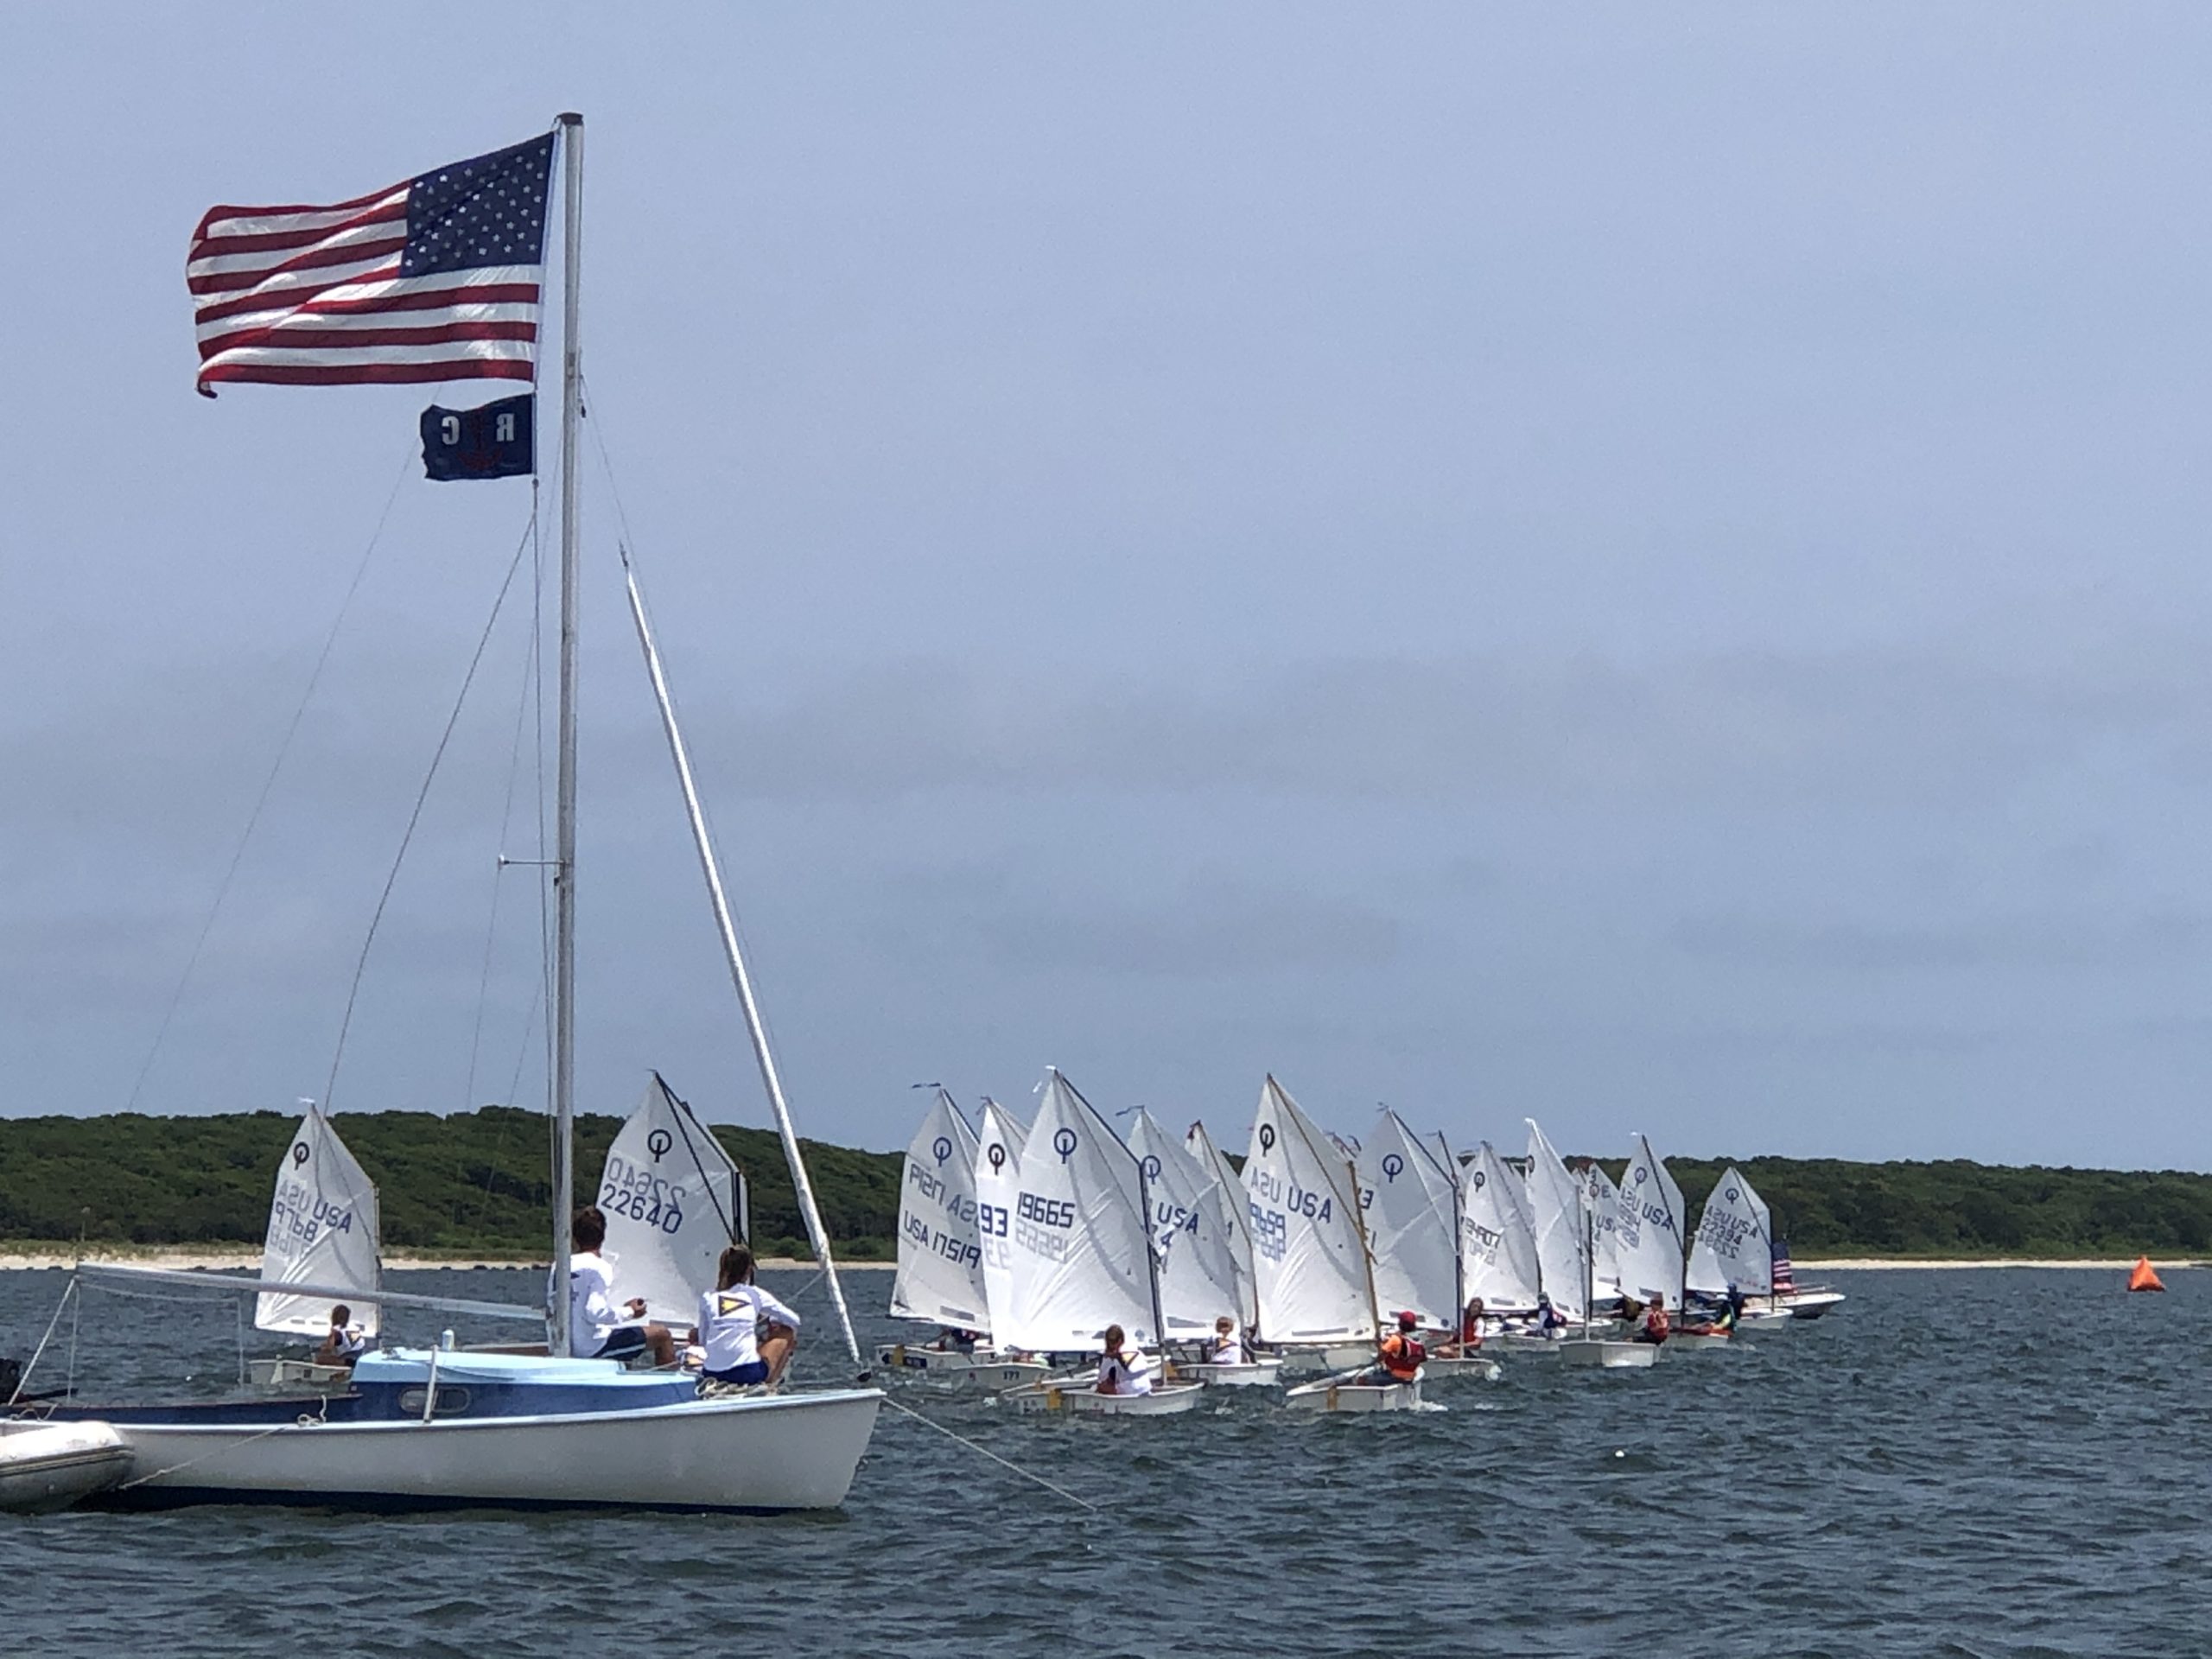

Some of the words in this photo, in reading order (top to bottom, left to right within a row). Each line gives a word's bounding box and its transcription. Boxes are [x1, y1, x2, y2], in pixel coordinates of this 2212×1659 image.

[276, 1201, 319, 1242] 9768
[313, 1198, 352, 1234] USA
[601, 1183, 683, 1234] 22640
[1016, 1191, 1076, 1229] 19665
[1157, 1201, 1198, 1235] USA
[1287, 1185, 1332, 1224] USA
[1642, 1202, 1673, 1230] USA
[904, 1210, 929, 1247] USA
[932, 1230, 982, 1269] 17519
[1731, 1217, 1758, 1238] USA
